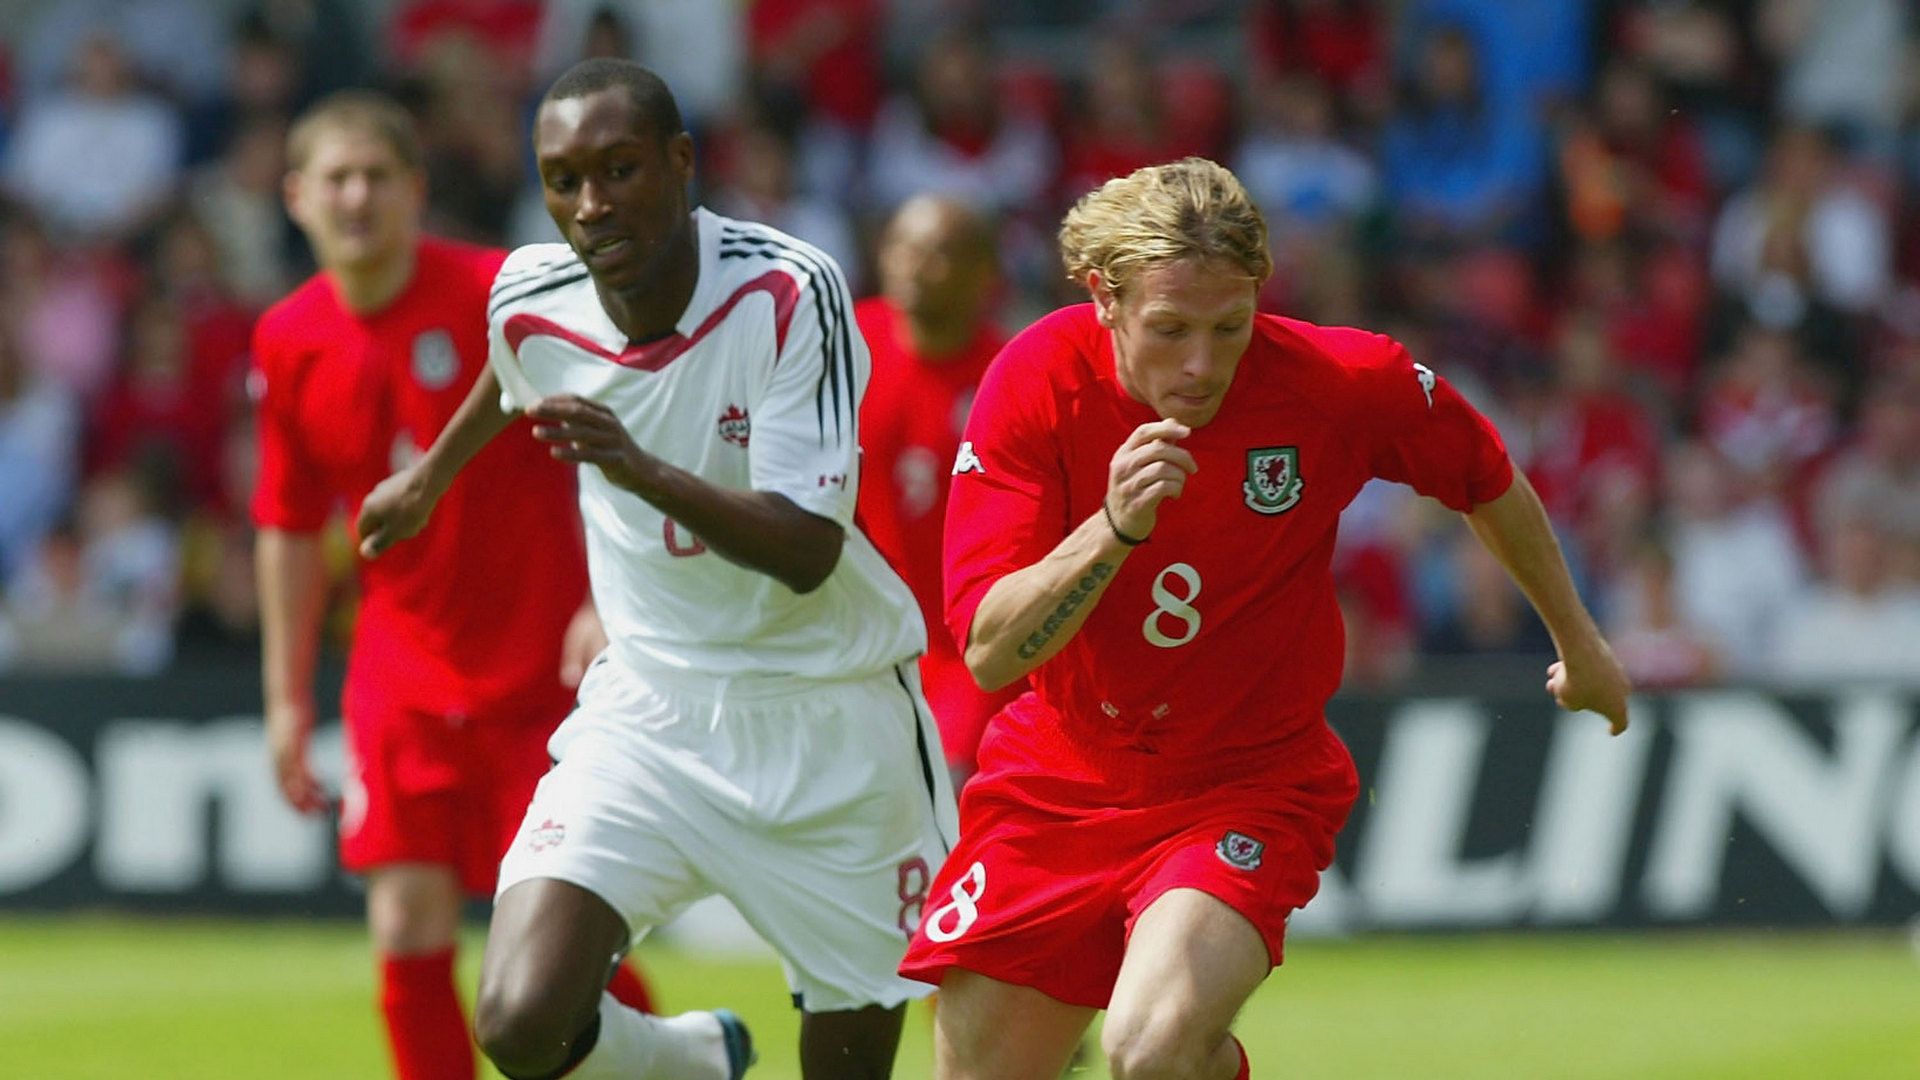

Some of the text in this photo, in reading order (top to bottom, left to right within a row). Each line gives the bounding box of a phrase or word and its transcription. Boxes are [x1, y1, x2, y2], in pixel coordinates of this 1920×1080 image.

[1142, 562, 1202, 648] 8
[1288, 690, 1920, 926] LIN
[897, 856, 930, 941] 8
[925, 861, 986, 943] 8
